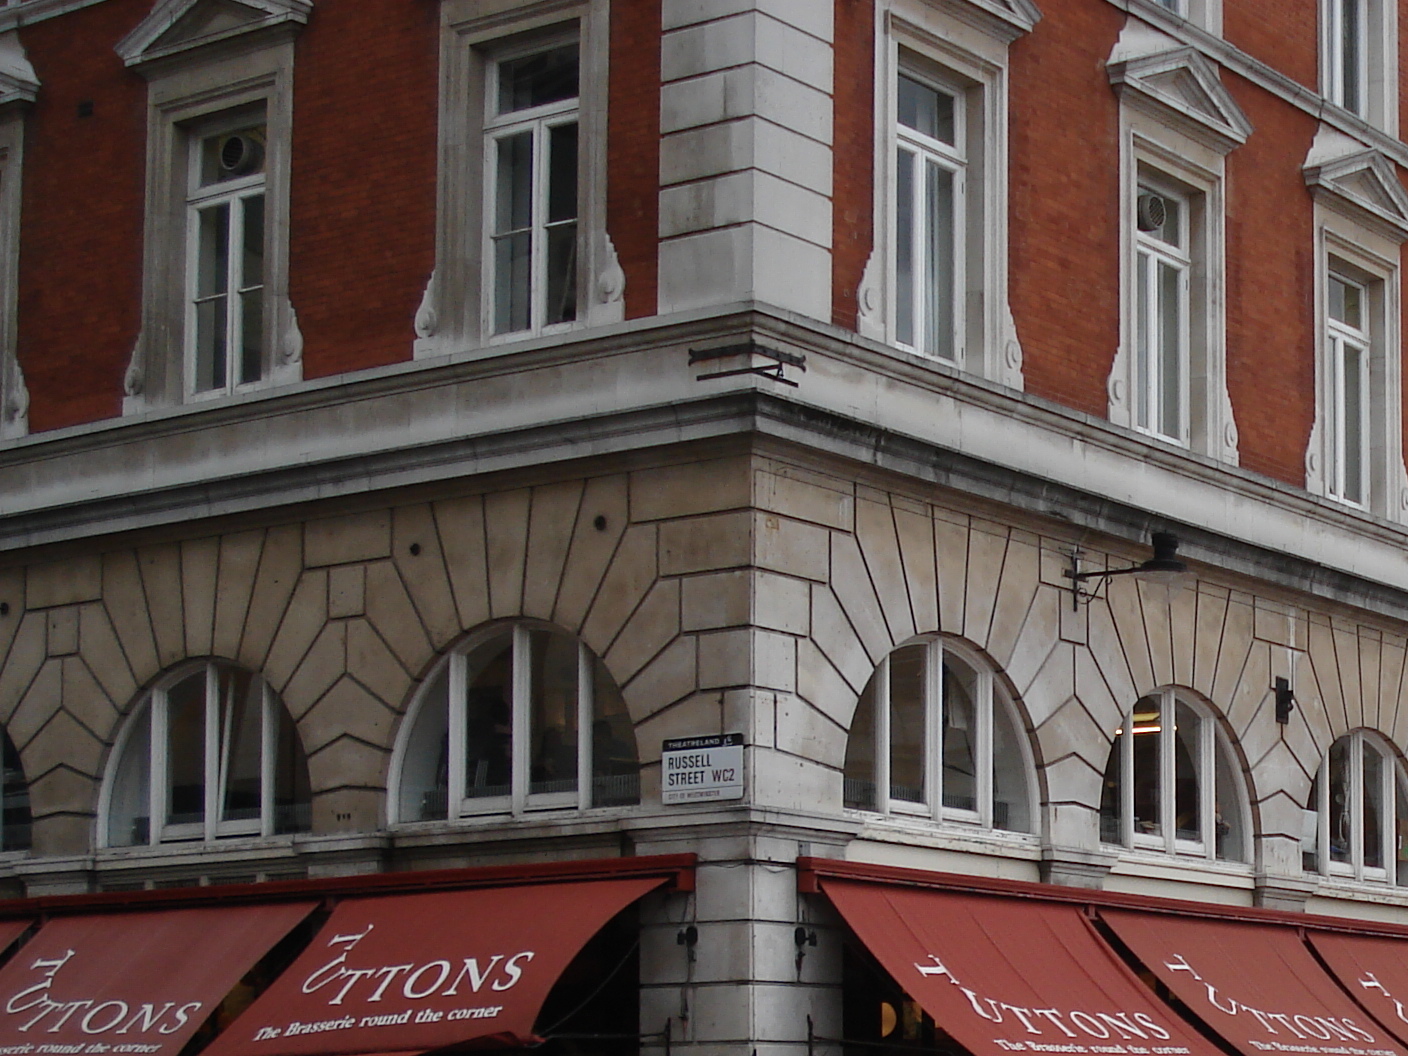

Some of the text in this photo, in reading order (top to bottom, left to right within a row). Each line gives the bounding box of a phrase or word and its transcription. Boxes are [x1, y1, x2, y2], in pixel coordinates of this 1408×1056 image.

[668, 738, 720, 748] THEATRELAND
[668, 753, 712, 770] RUSSELL
[668, 768, 734, 786] STREET WC2
[300, 923, 534, 1006] TUTTONS
[6, 948, 202, 1035] TUTTONS
[914, 953, 1171, 1041] TUTTONS
[1163, 953, 1375, 1044] TUTTONS
[253, 1005, 503, 1041] The Brasserie round the corner
[36, 1042, 86, 1054] round
[85, 1042, 112, 1054] the
[113, 1043, 162, 1054] corner
[993, 1039, 1027, 1051] The
